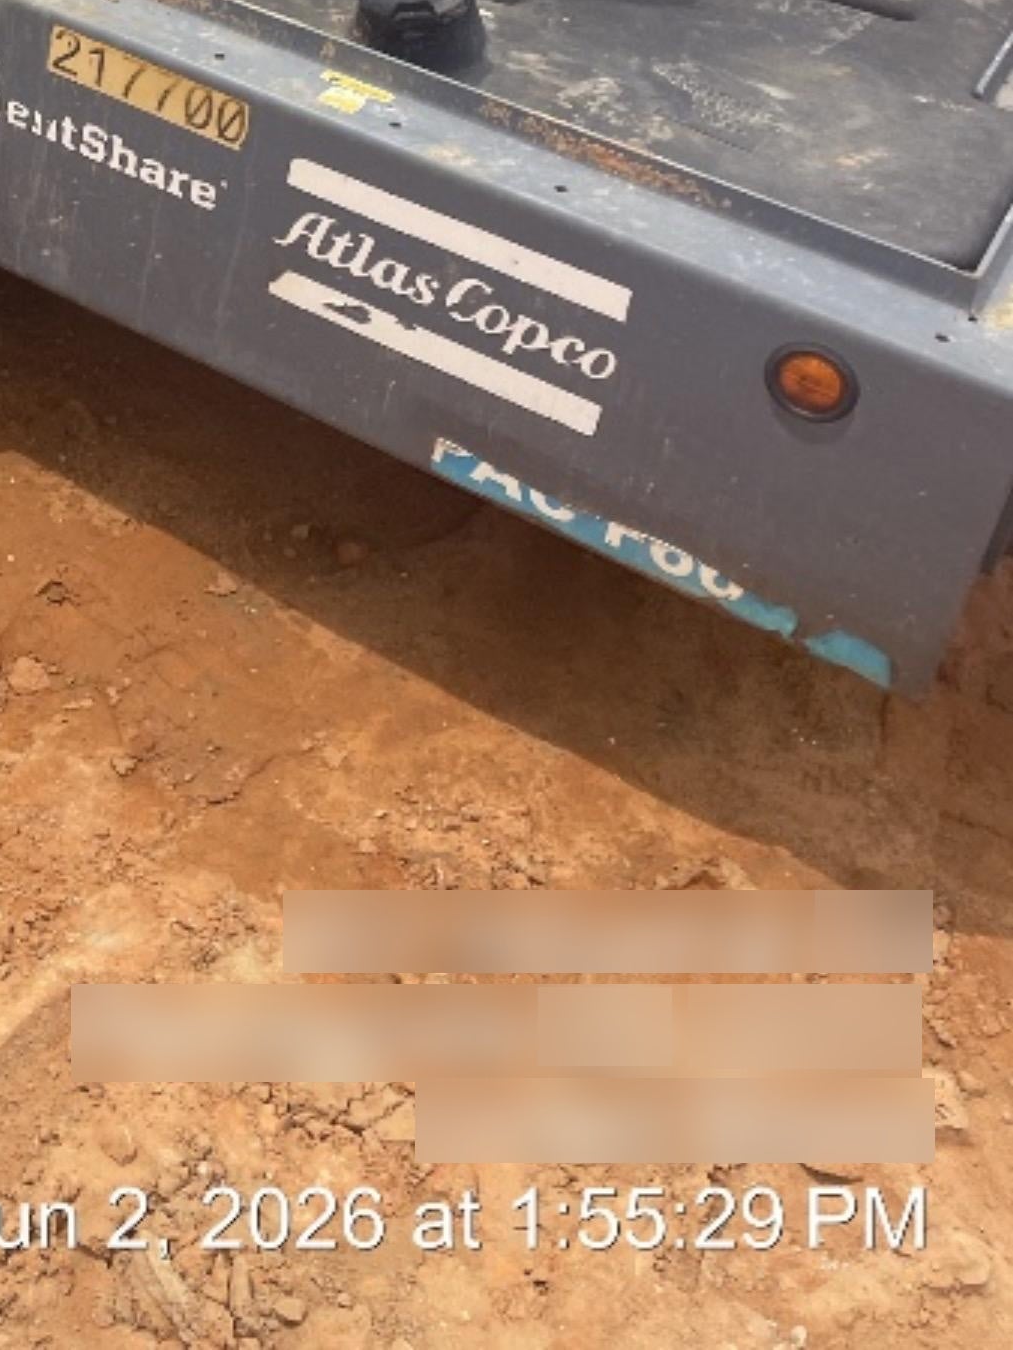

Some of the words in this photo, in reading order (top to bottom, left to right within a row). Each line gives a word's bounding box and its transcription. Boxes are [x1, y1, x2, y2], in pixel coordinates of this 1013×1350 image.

[52, 29, 246, 143] 217700
[275, 211, 441, 306] Atlas
[445, 278, 618, 380] Copco
